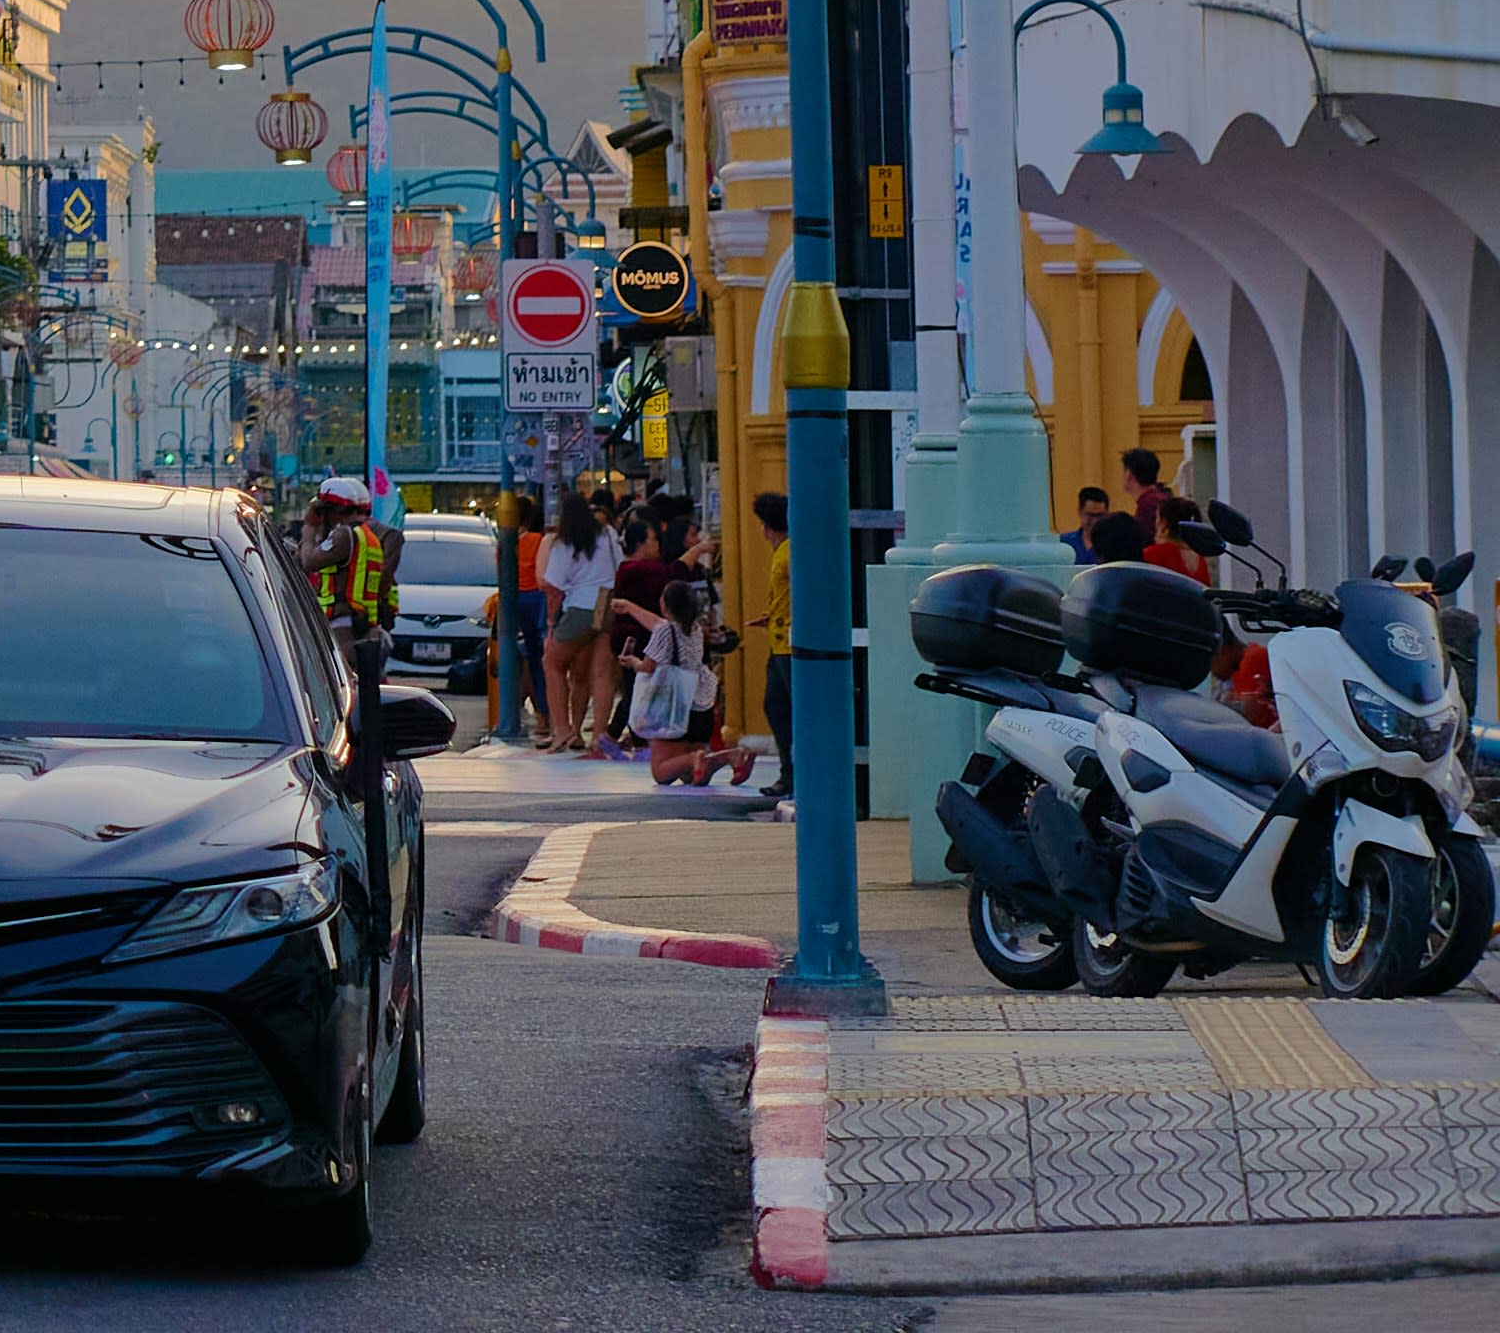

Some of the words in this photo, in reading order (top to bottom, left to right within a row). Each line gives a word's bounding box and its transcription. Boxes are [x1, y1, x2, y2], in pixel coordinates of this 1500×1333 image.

[512, 358, 590, 384] ห้ามเข้า
[519, 392, 537, 403] NO
[542, 392, 582, 403] ENTRY
[1045, 718, 1086, 742] POLICE
